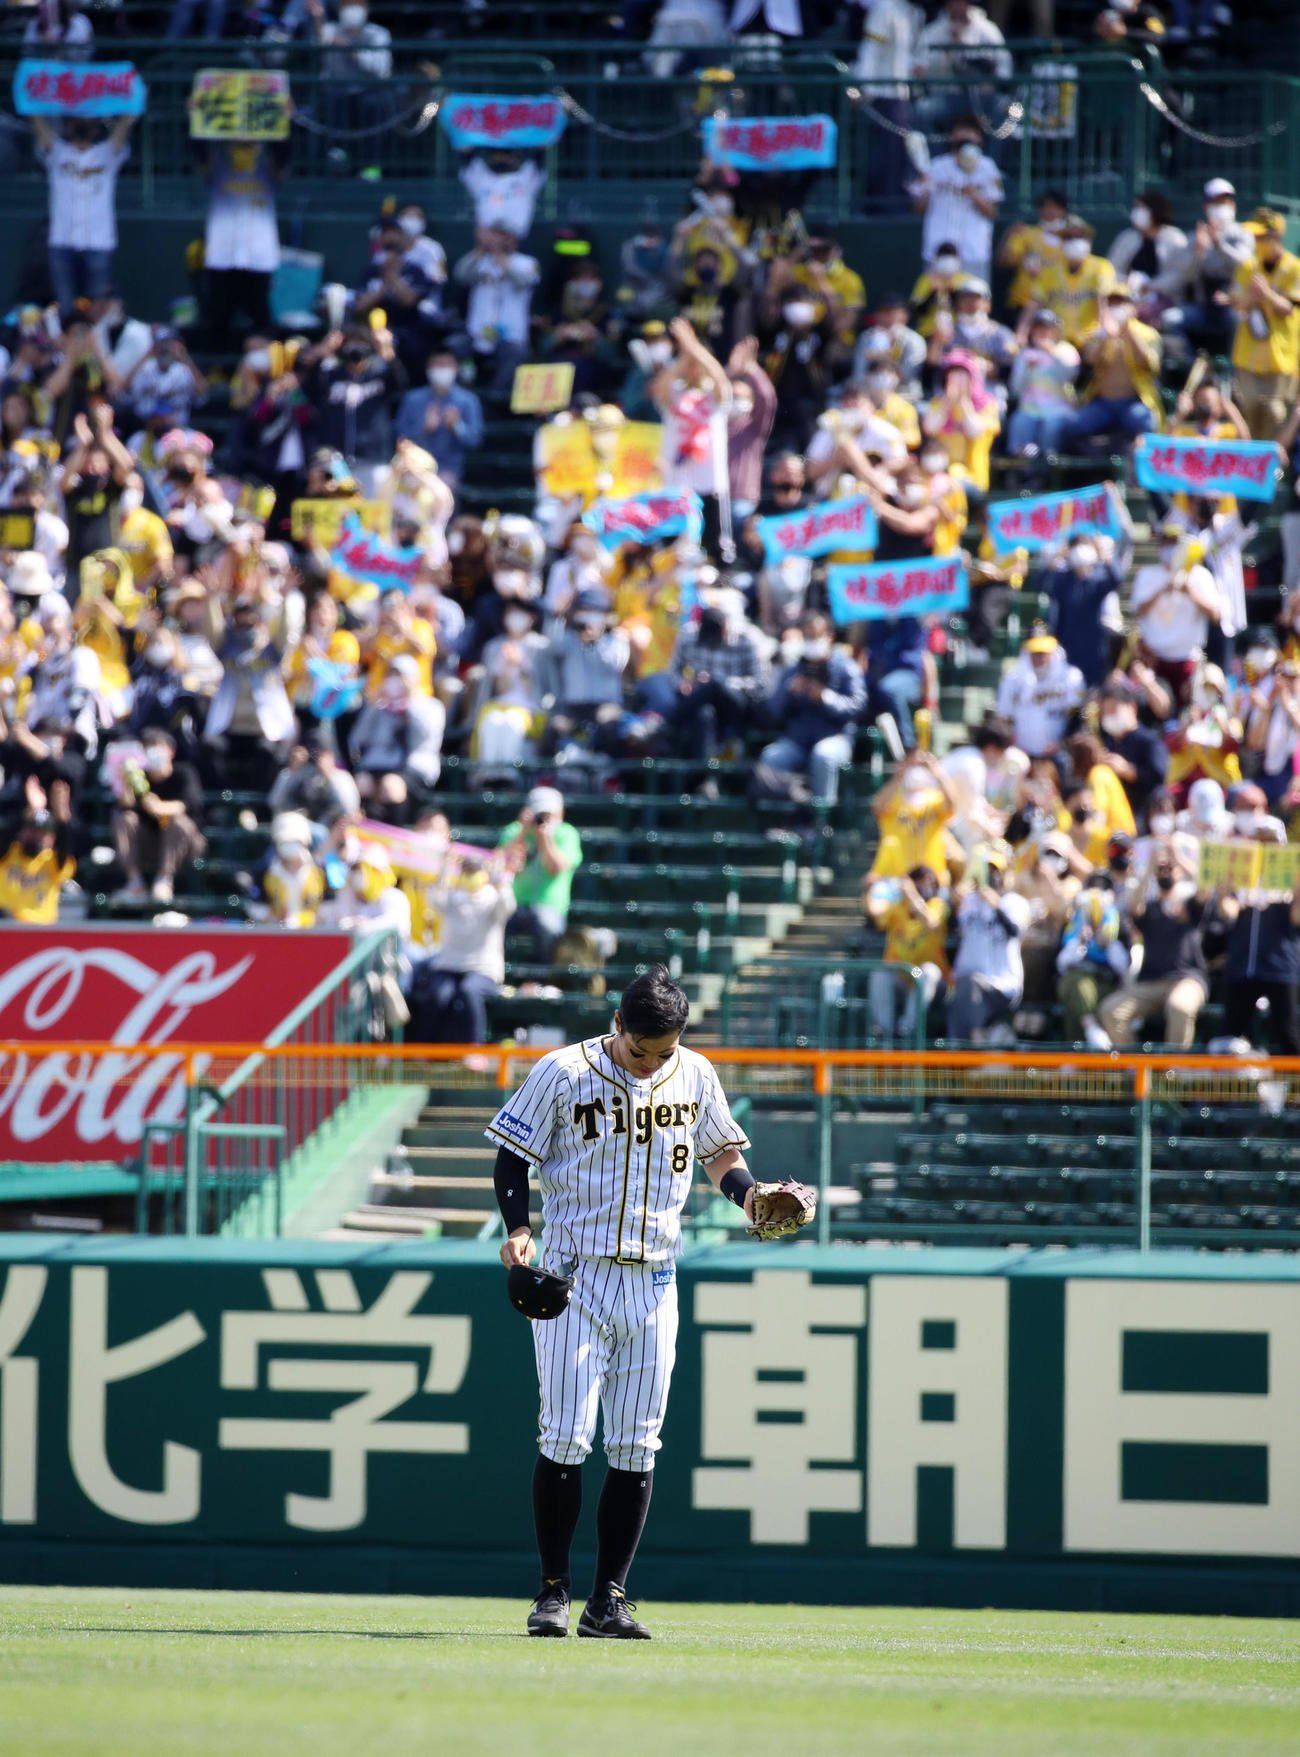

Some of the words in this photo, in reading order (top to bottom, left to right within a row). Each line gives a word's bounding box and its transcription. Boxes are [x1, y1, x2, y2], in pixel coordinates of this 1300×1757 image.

[499, 1115, 530, 1140] Joshin
[573, 1096, 699, 1144] Tigers
[671, 1143, 690, 1174] 8
[0, 1266, 470, 1529] 化学
[692, 1270, 1300, 1556] 朝日
